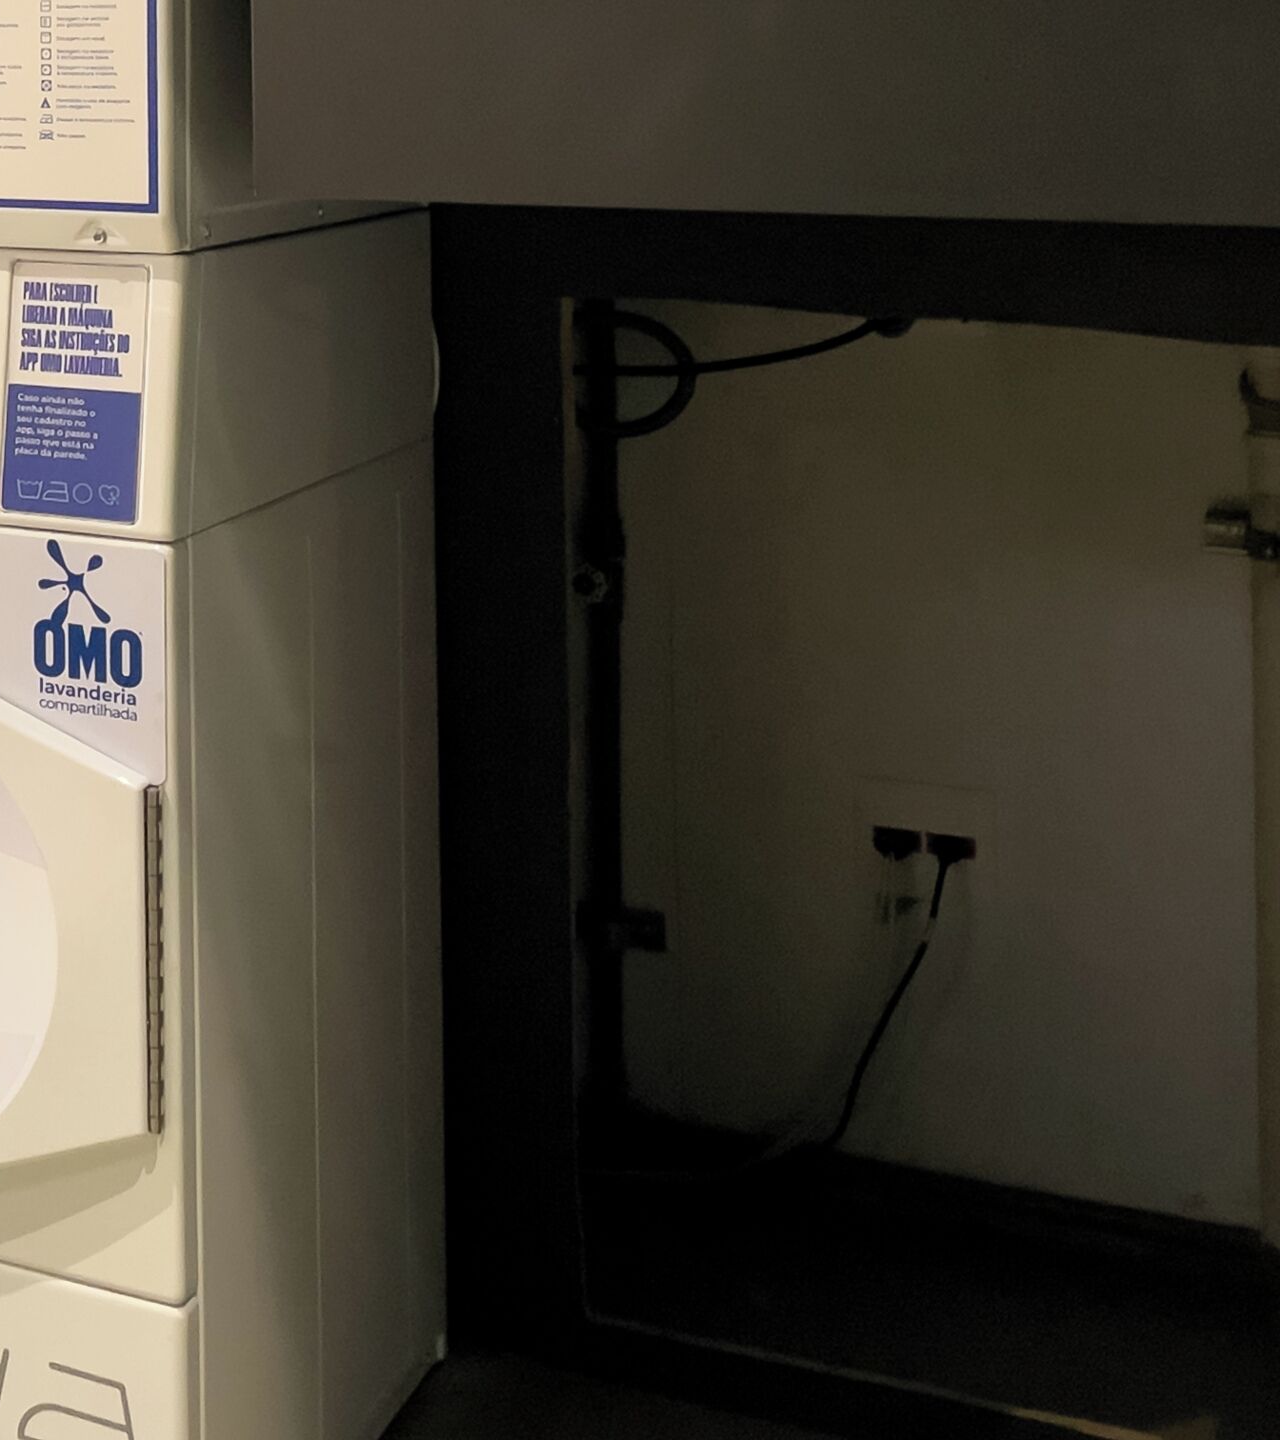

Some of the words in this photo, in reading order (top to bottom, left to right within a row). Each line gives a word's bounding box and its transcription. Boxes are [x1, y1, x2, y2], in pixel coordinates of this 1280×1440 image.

[44, 330, 56, 348] AS
[18, 393, 39, 402] Caso
[41, 396, 65, 404] ainda
[68, 397, 84, 405] não
[17, 404, 42, 413] tenha
[45, 406, 87, 417] finalizado
[34, 416, 72, 426] cadastro
[37, 427, 55, 437] siga
[65, 430, 90, 439] passo
[15, 437, 40, 445] passo
[42, 440, 59, 448] que
[62, 440, 80, 448] está
[15, 447, 38, 456] placa
[34, 619, 142, 688] OMO
[40, 677, 136, 706] lavanderia
[39, 699, 137, 721] compartilhada
